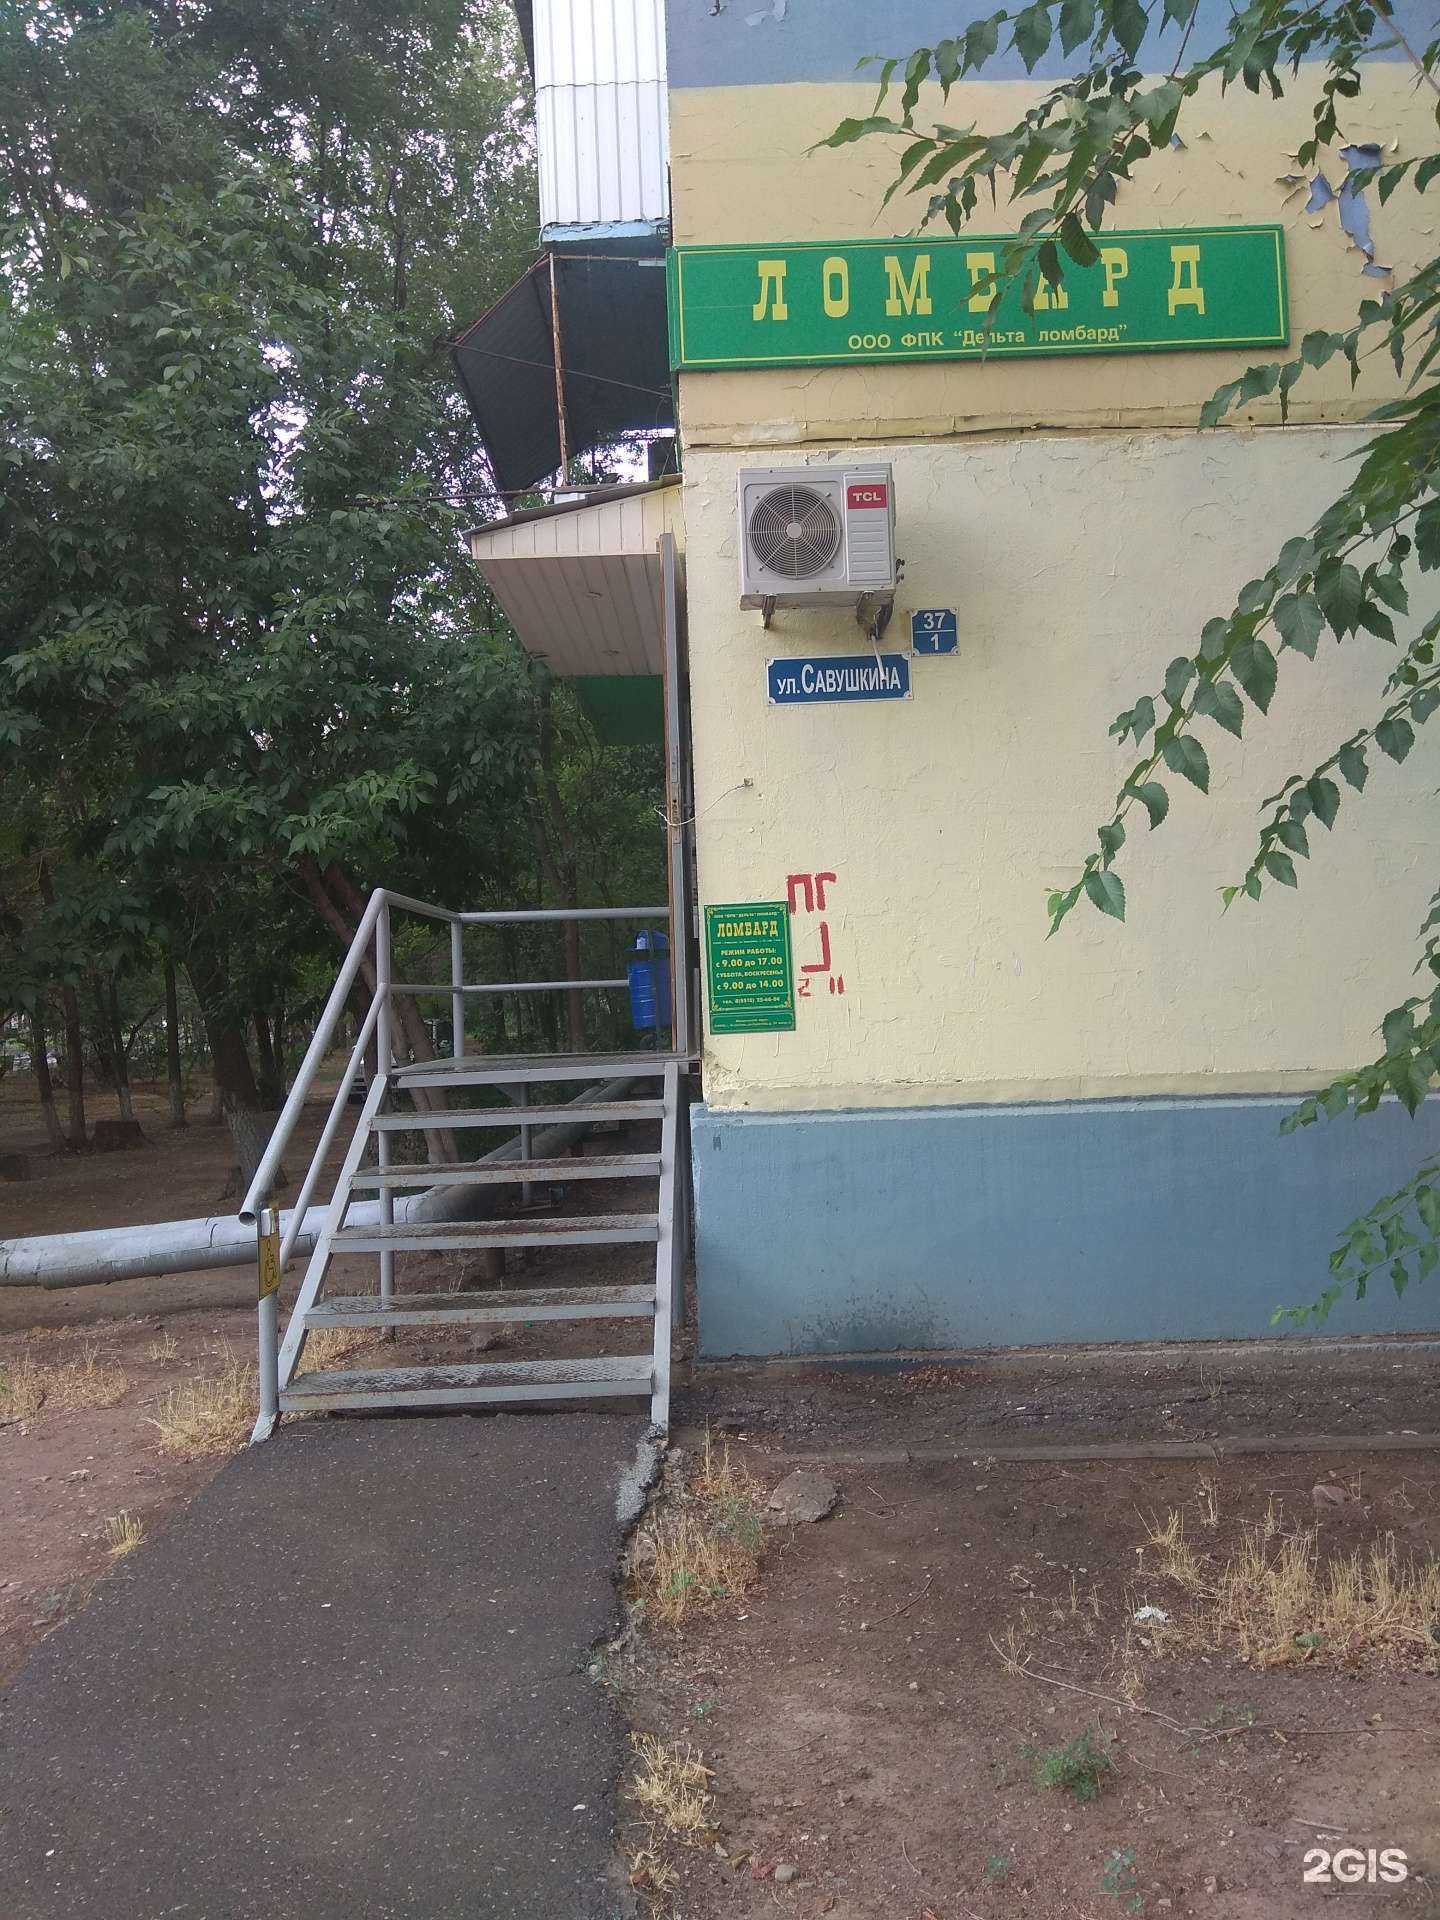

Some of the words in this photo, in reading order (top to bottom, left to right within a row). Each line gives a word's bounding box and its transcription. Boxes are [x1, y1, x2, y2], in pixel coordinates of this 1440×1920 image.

[848, 334, 891, 349] ООО
[901, 332, 944, 346] ФПК
[853, 490, 882, 502] TCL
[923, 612, 946, 630] 37
[930, 633, 940, 651] 1
[717, 920, 779, 938] ЛОМБАРД
[721, 958, 743, 968] 9.00
[744, 960, 756, 968] до
[758, 956, 783, 966] 17.00
[722, 980, 744, 990] 9.00
[745, 982, 757, 990] до
[759, 979, 784, 988] 14.00
